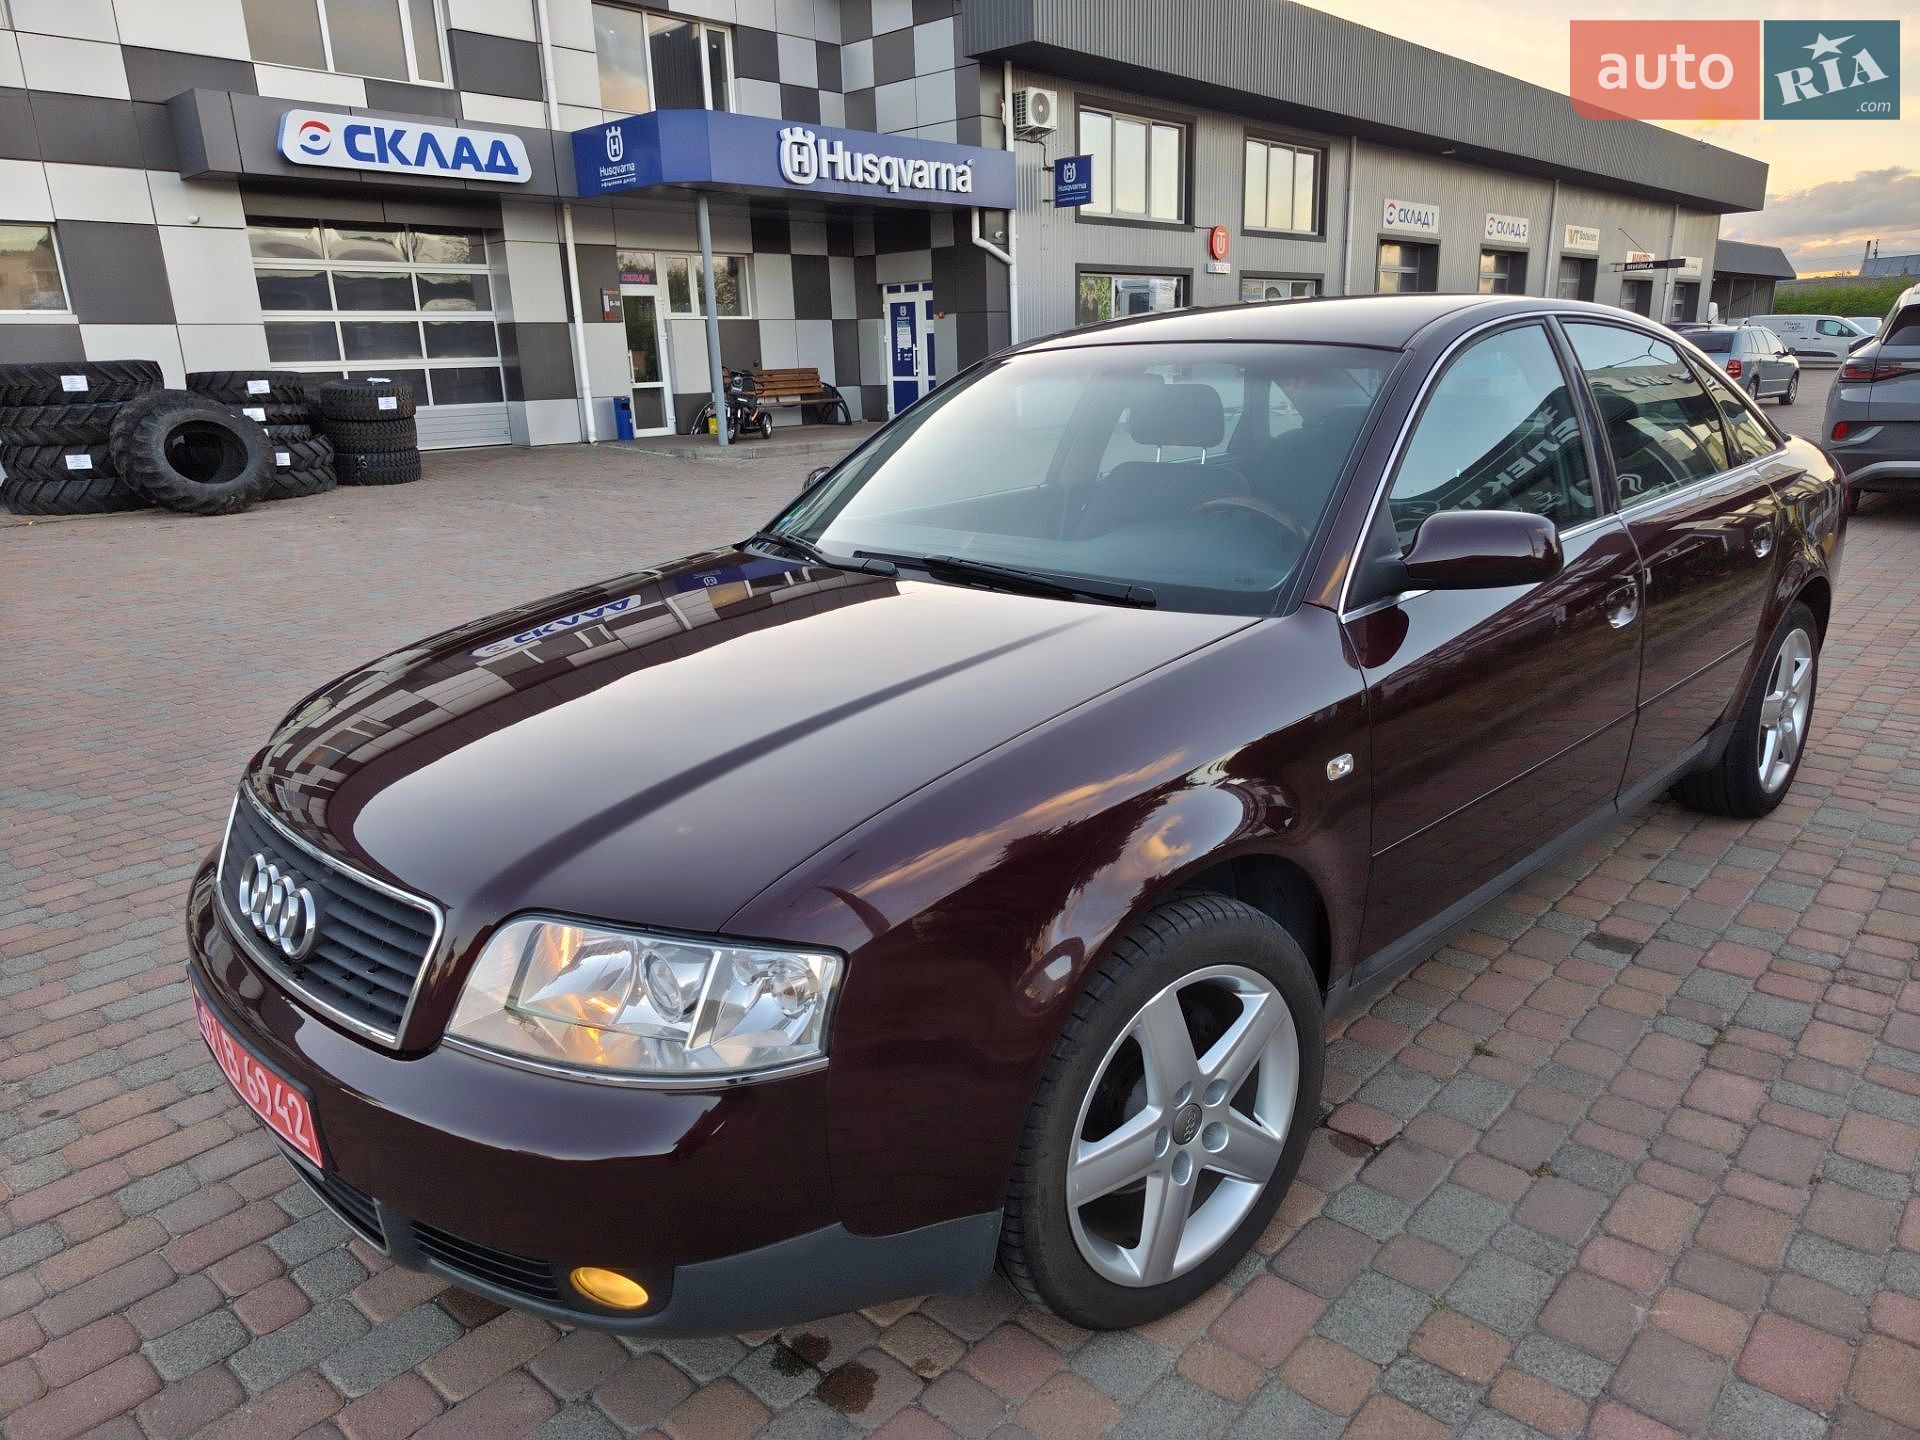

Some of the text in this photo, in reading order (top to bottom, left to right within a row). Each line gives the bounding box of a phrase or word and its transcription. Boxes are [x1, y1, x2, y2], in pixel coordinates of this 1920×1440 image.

[343, 124, 519, 176] СКЛАД
[818, 138, 974, 193] Husqvarna
[599, 162, 636, 178] Husqvarna
[1398, 208, 1430, 229] СКЛАД
[1496, 221, 1521, 239] СКЛАД
[244, 1055, 311, 1148] 6942
